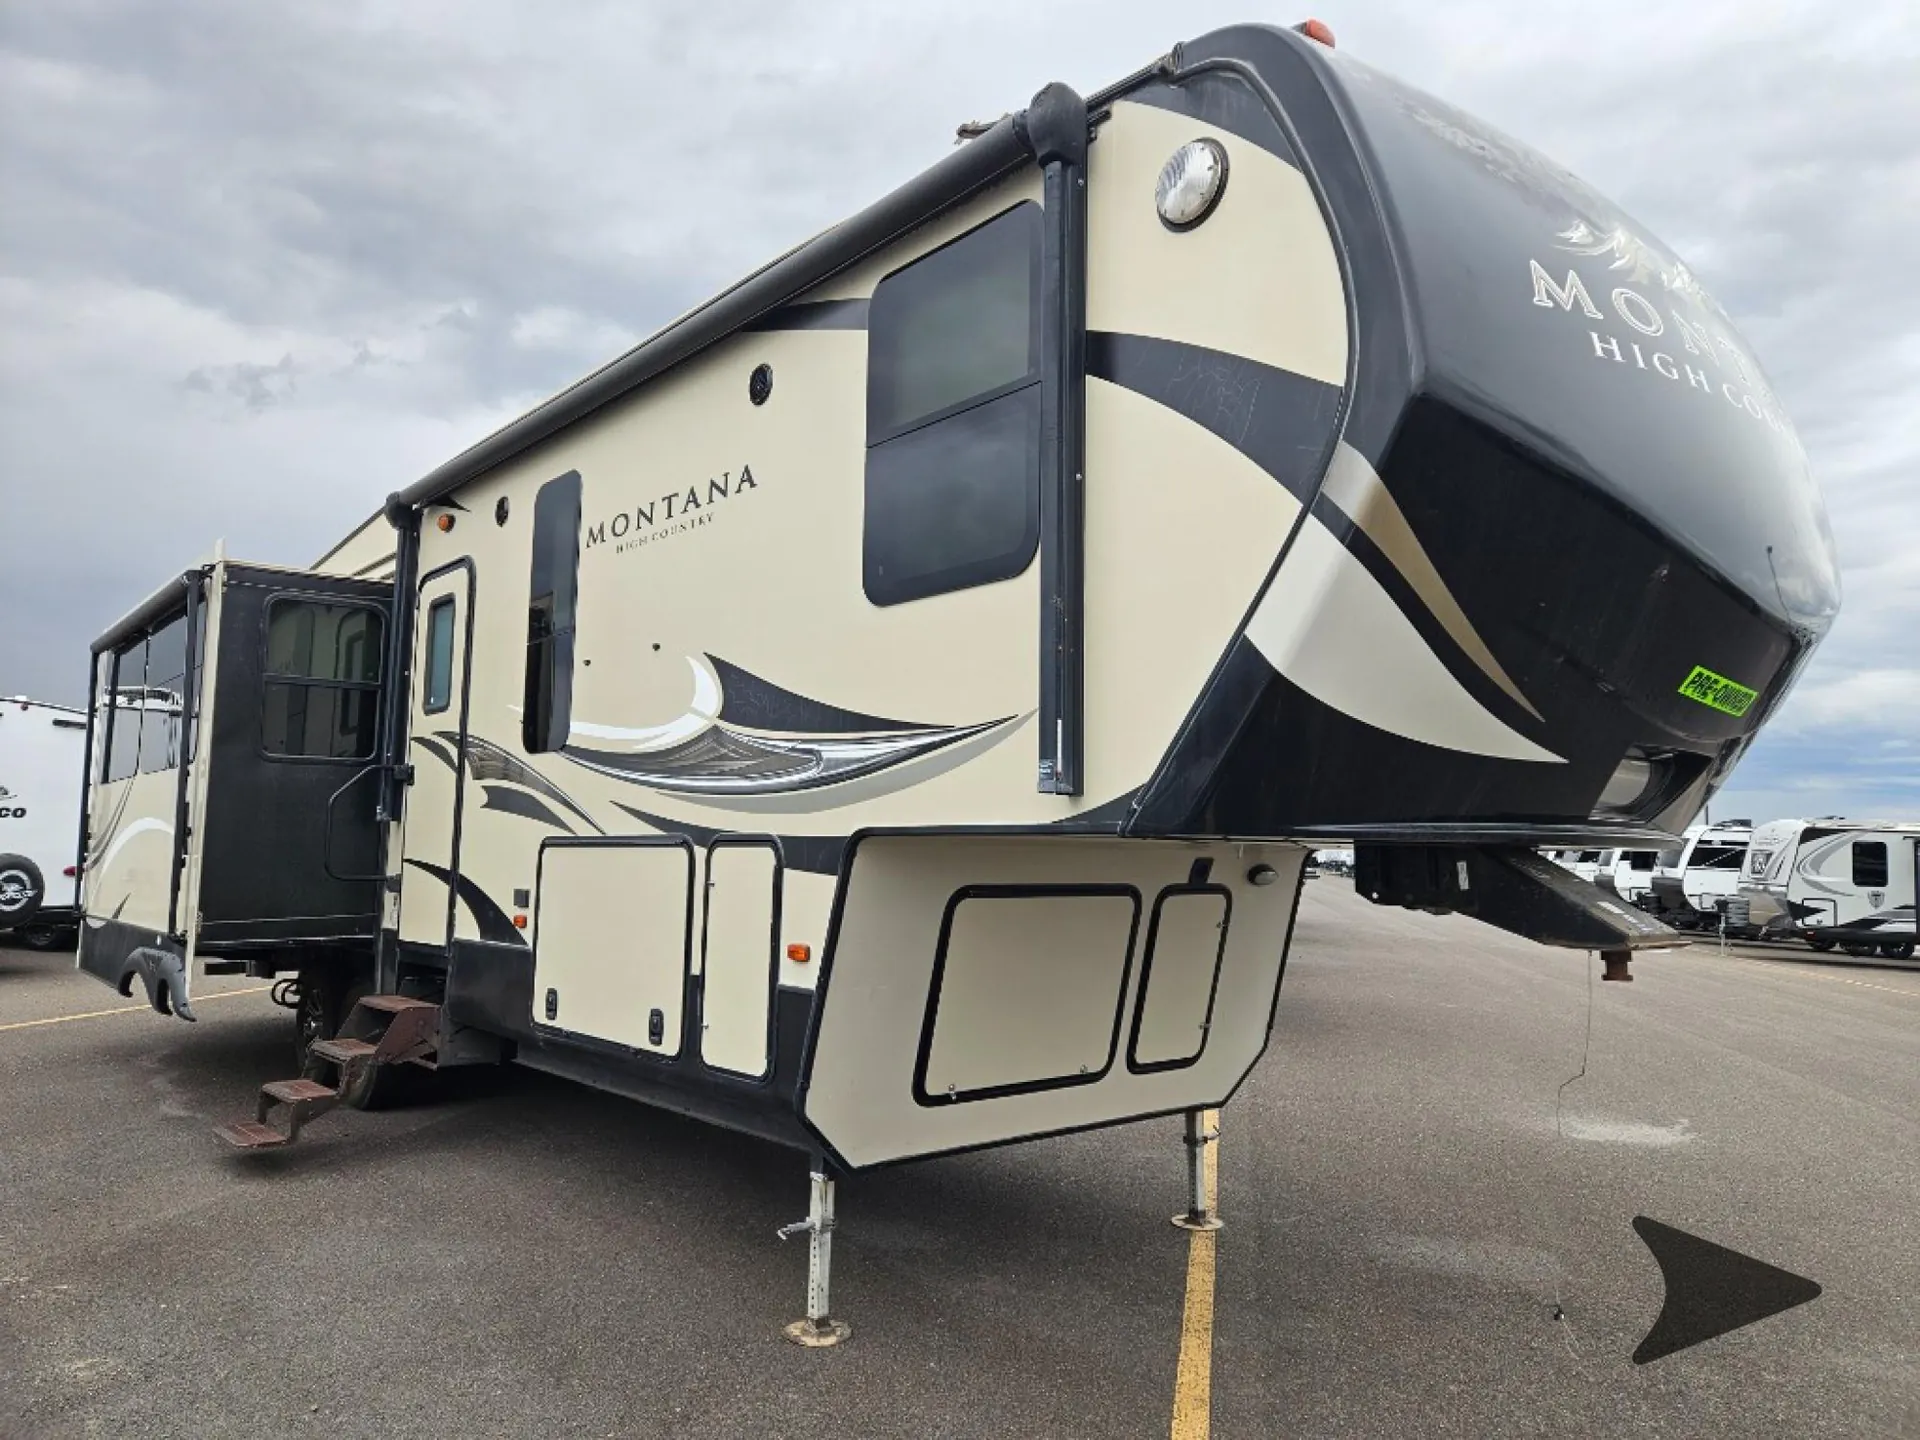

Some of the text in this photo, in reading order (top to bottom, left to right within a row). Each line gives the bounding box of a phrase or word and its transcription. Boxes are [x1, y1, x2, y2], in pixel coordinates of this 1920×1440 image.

[1529, 258, 1766, 390] MONT
[1588, 330, 1712, 393] HIGH
[585, 463, 758, 549] MONTANA
[616, 511, 715, 554] HIGH COUNTRY
